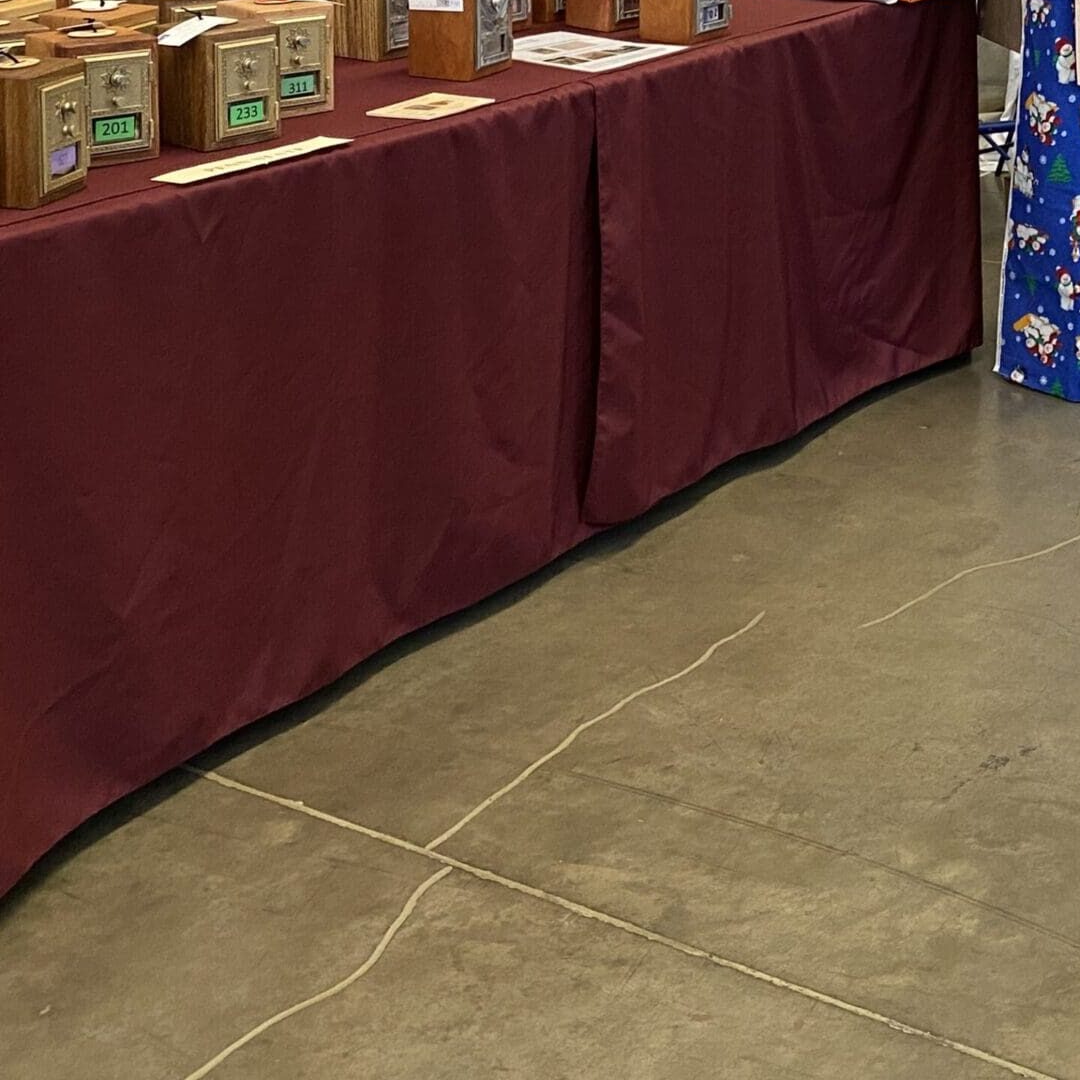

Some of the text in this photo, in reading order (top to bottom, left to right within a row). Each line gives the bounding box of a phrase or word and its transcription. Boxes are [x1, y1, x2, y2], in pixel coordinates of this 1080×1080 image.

[289, 83, 308, 94] 311
[236, 105, 258, 120] 233
[102, 121, 129, 136] 201
